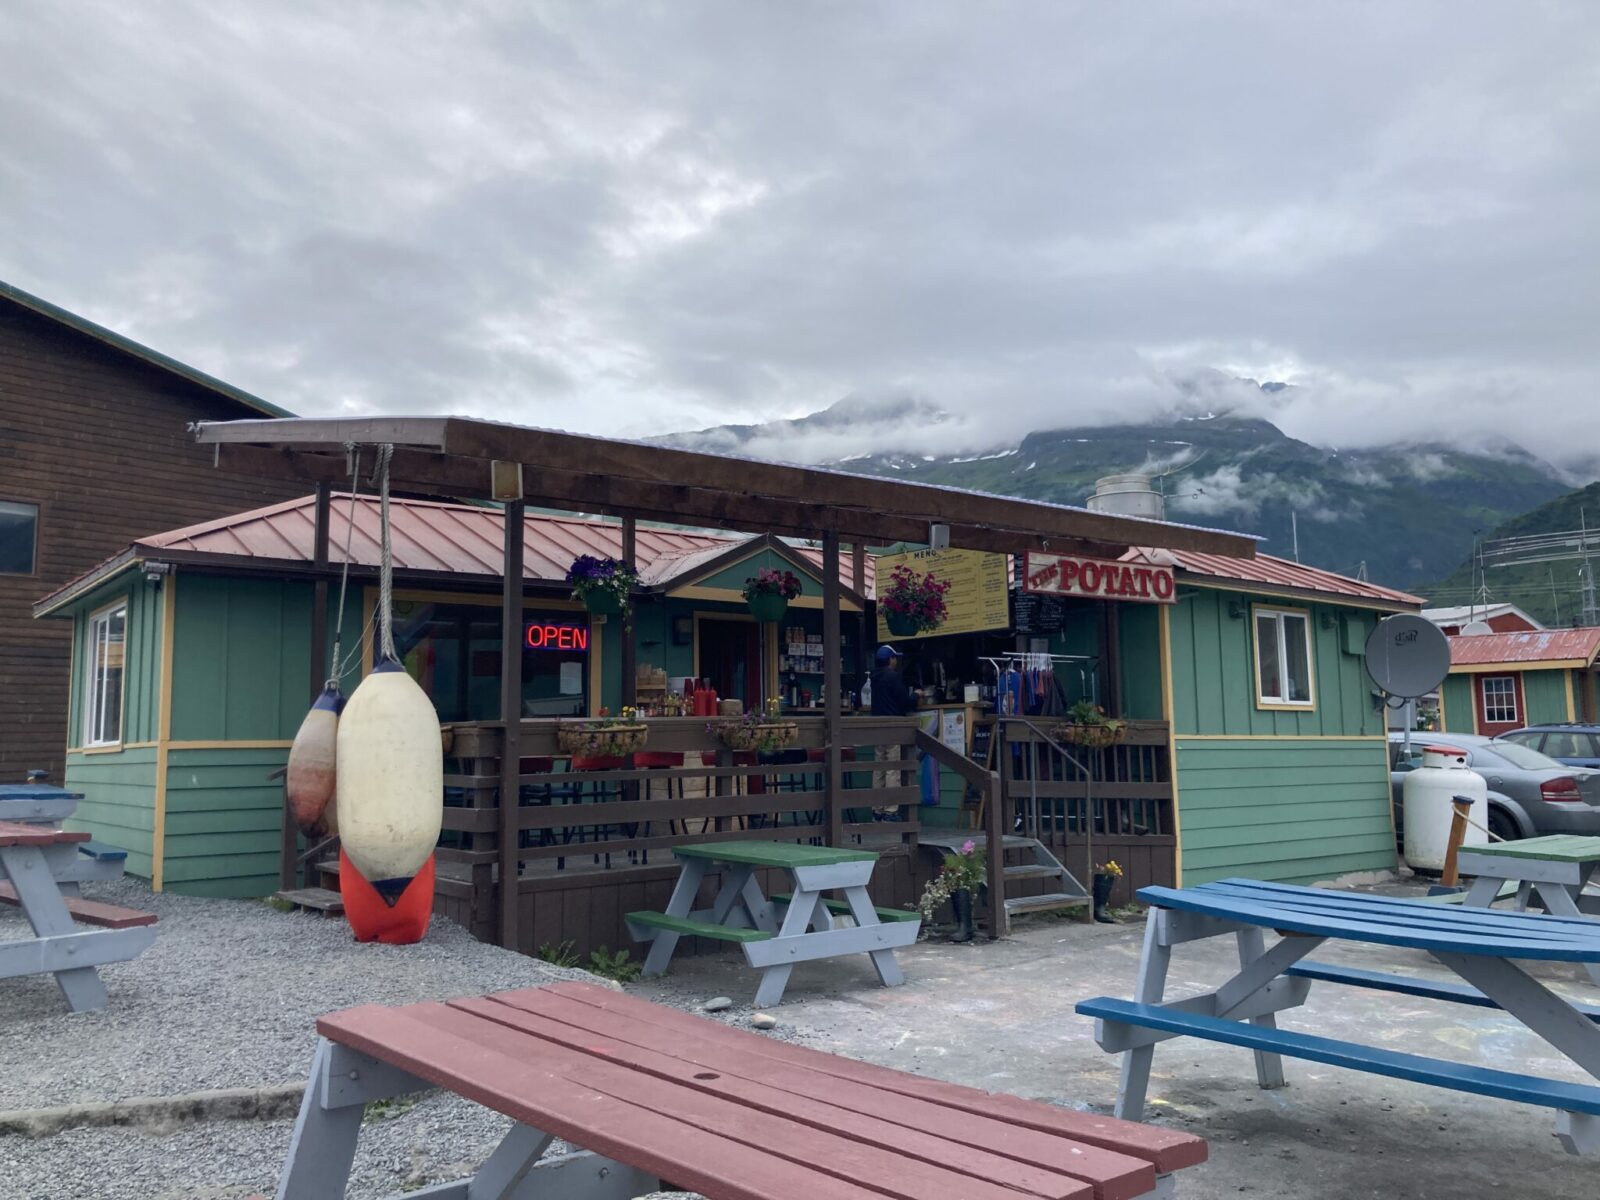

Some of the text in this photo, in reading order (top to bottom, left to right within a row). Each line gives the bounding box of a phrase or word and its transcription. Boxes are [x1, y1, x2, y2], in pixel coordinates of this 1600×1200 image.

[914, 549, 937, 559] MENU
[1029, 563, 1058, 588] THE
[1058, 559, 1173, 599] POTATO
[528, 625, 587, 649] OPEN
